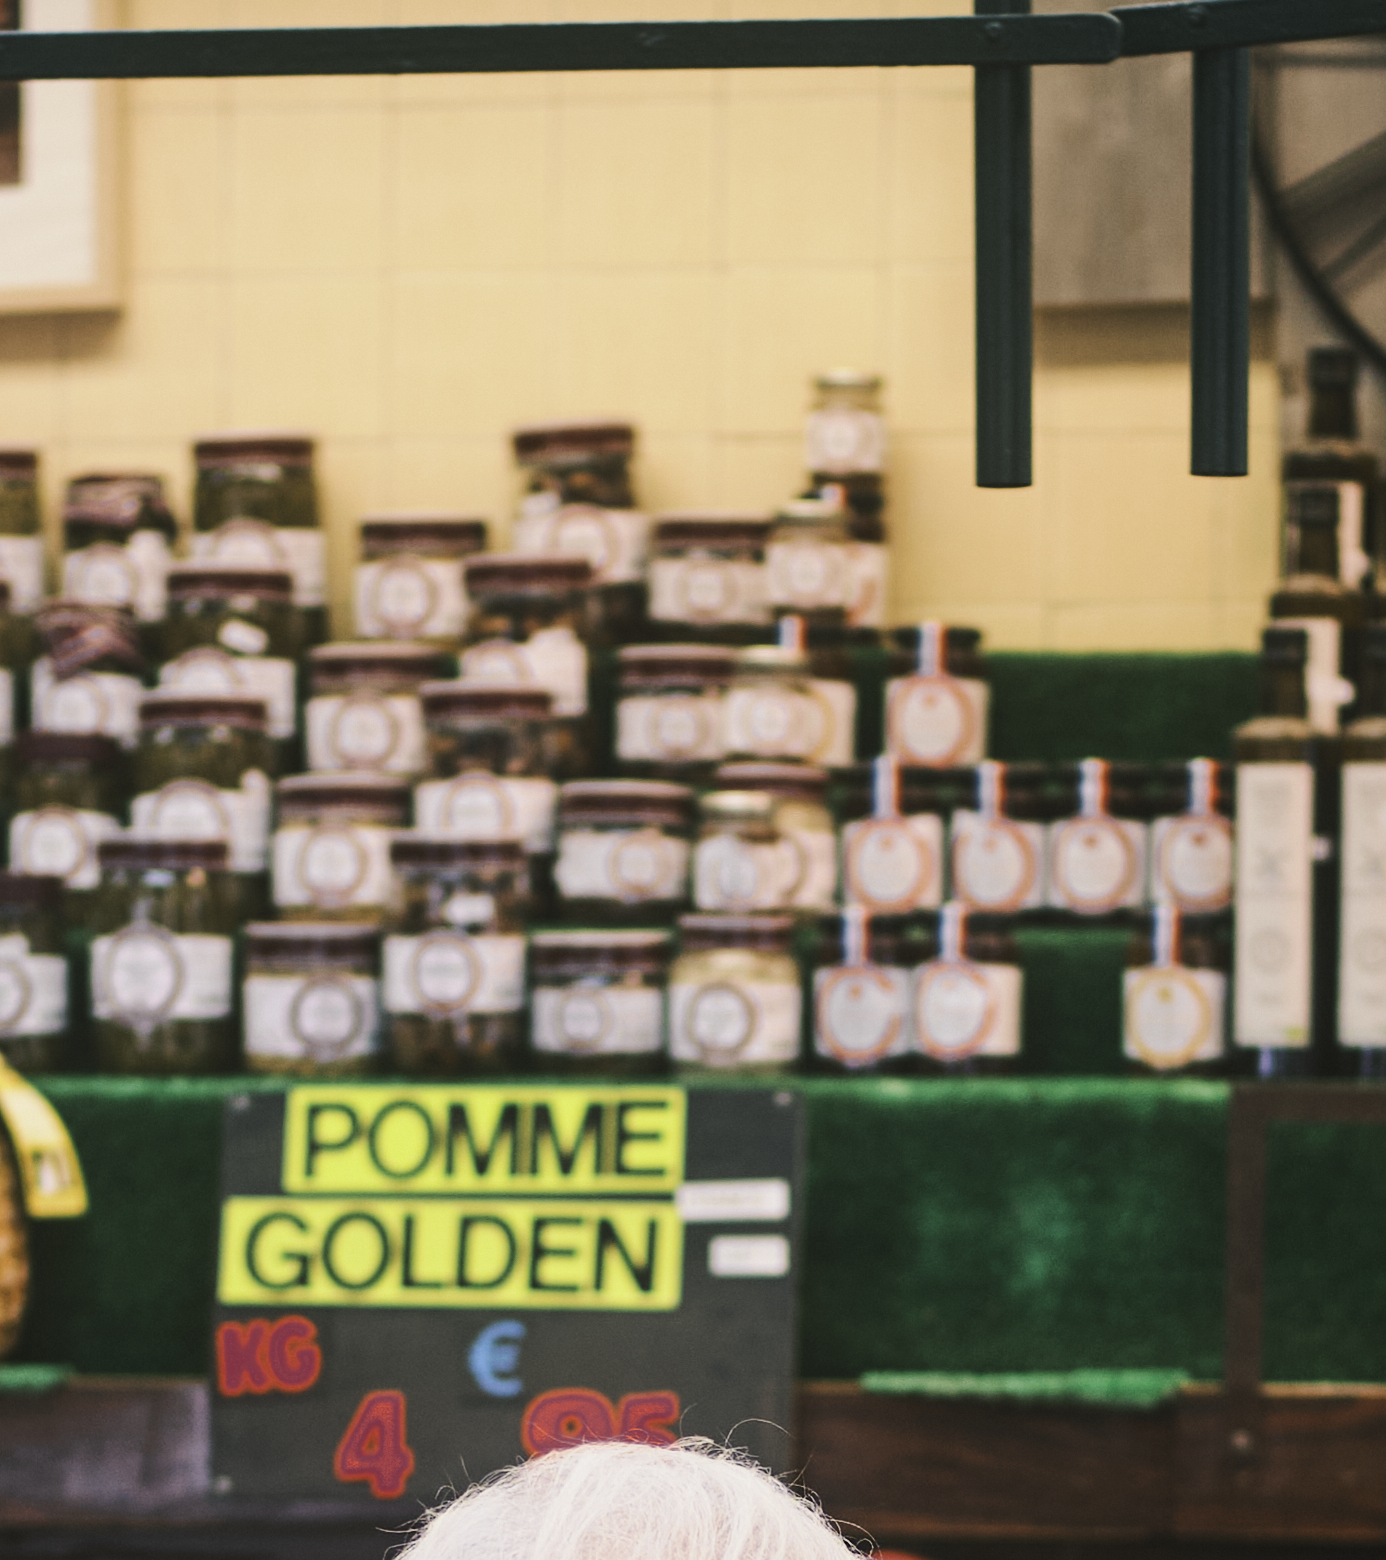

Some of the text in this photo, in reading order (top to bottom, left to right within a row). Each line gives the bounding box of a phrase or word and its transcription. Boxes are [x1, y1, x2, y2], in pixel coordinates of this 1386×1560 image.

[304, 1100, 670, 1178] POMME
[246, 1211, 659, 1293] GOLDEN
[217, 1315, 526, 1397] KG €
